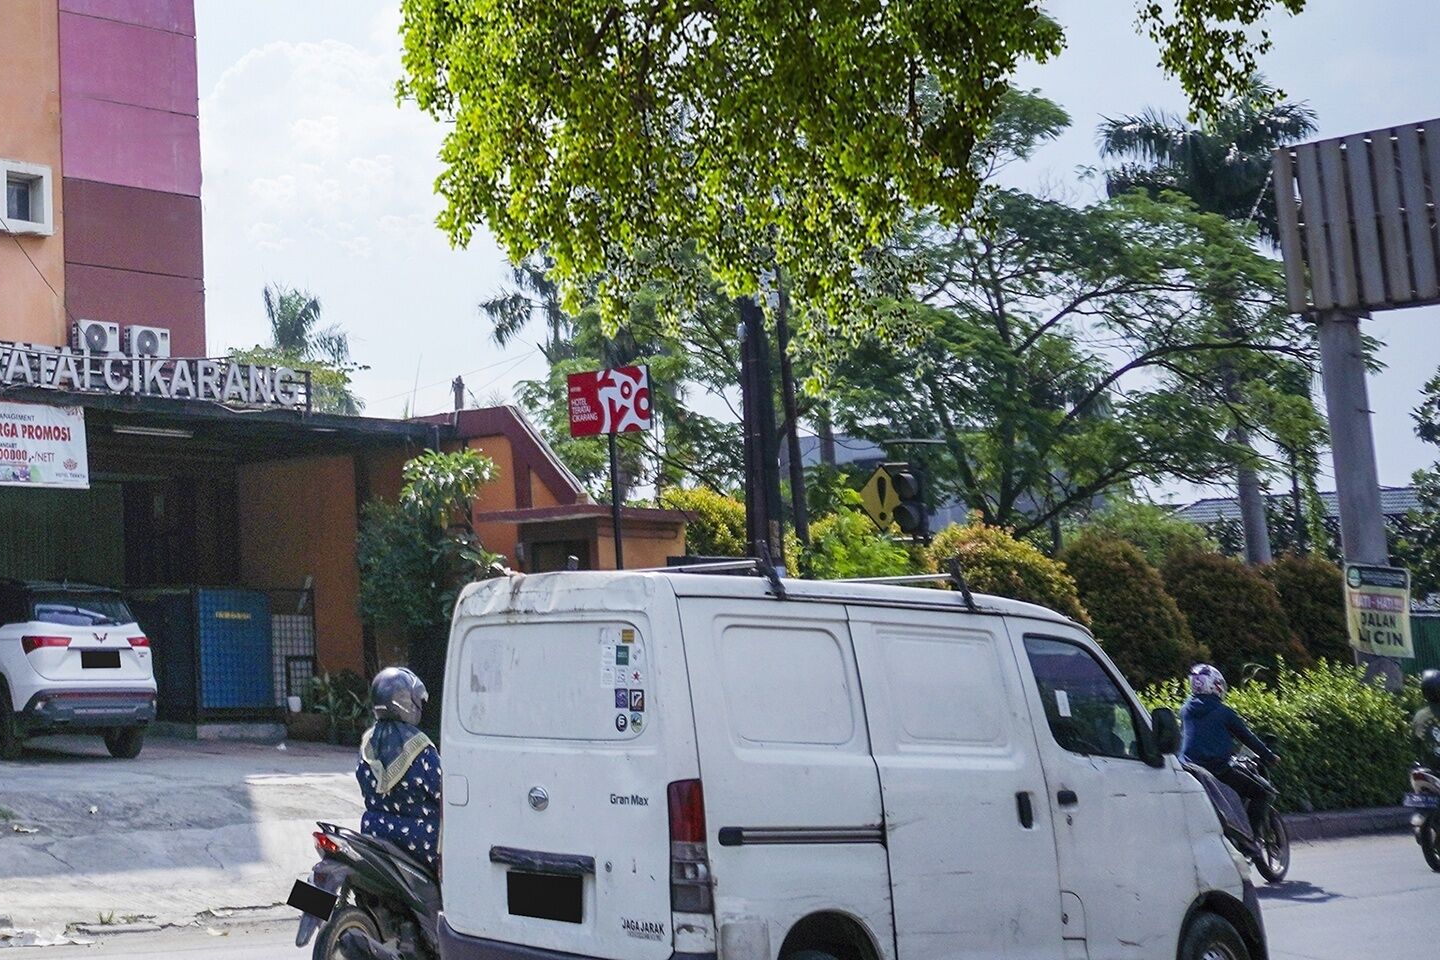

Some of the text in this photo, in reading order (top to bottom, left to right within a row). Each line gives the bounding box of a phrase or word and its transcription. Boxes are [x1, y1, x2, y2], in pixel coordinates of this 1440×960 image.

[103, 350, 300, 407] CIKARANG
[571, 398, 587, 406] HOTEL
[572, 413, 598, 423] CIKARANG
[21, 424, 71, 442] PROMOSI
[1361, 612, 1396, 628] JALAN
[1358, 628, 1404, 647] LICIN
[610, 794, 649, 806] Gran Max
[622, 919, 665, 936] JAGA JARAK
